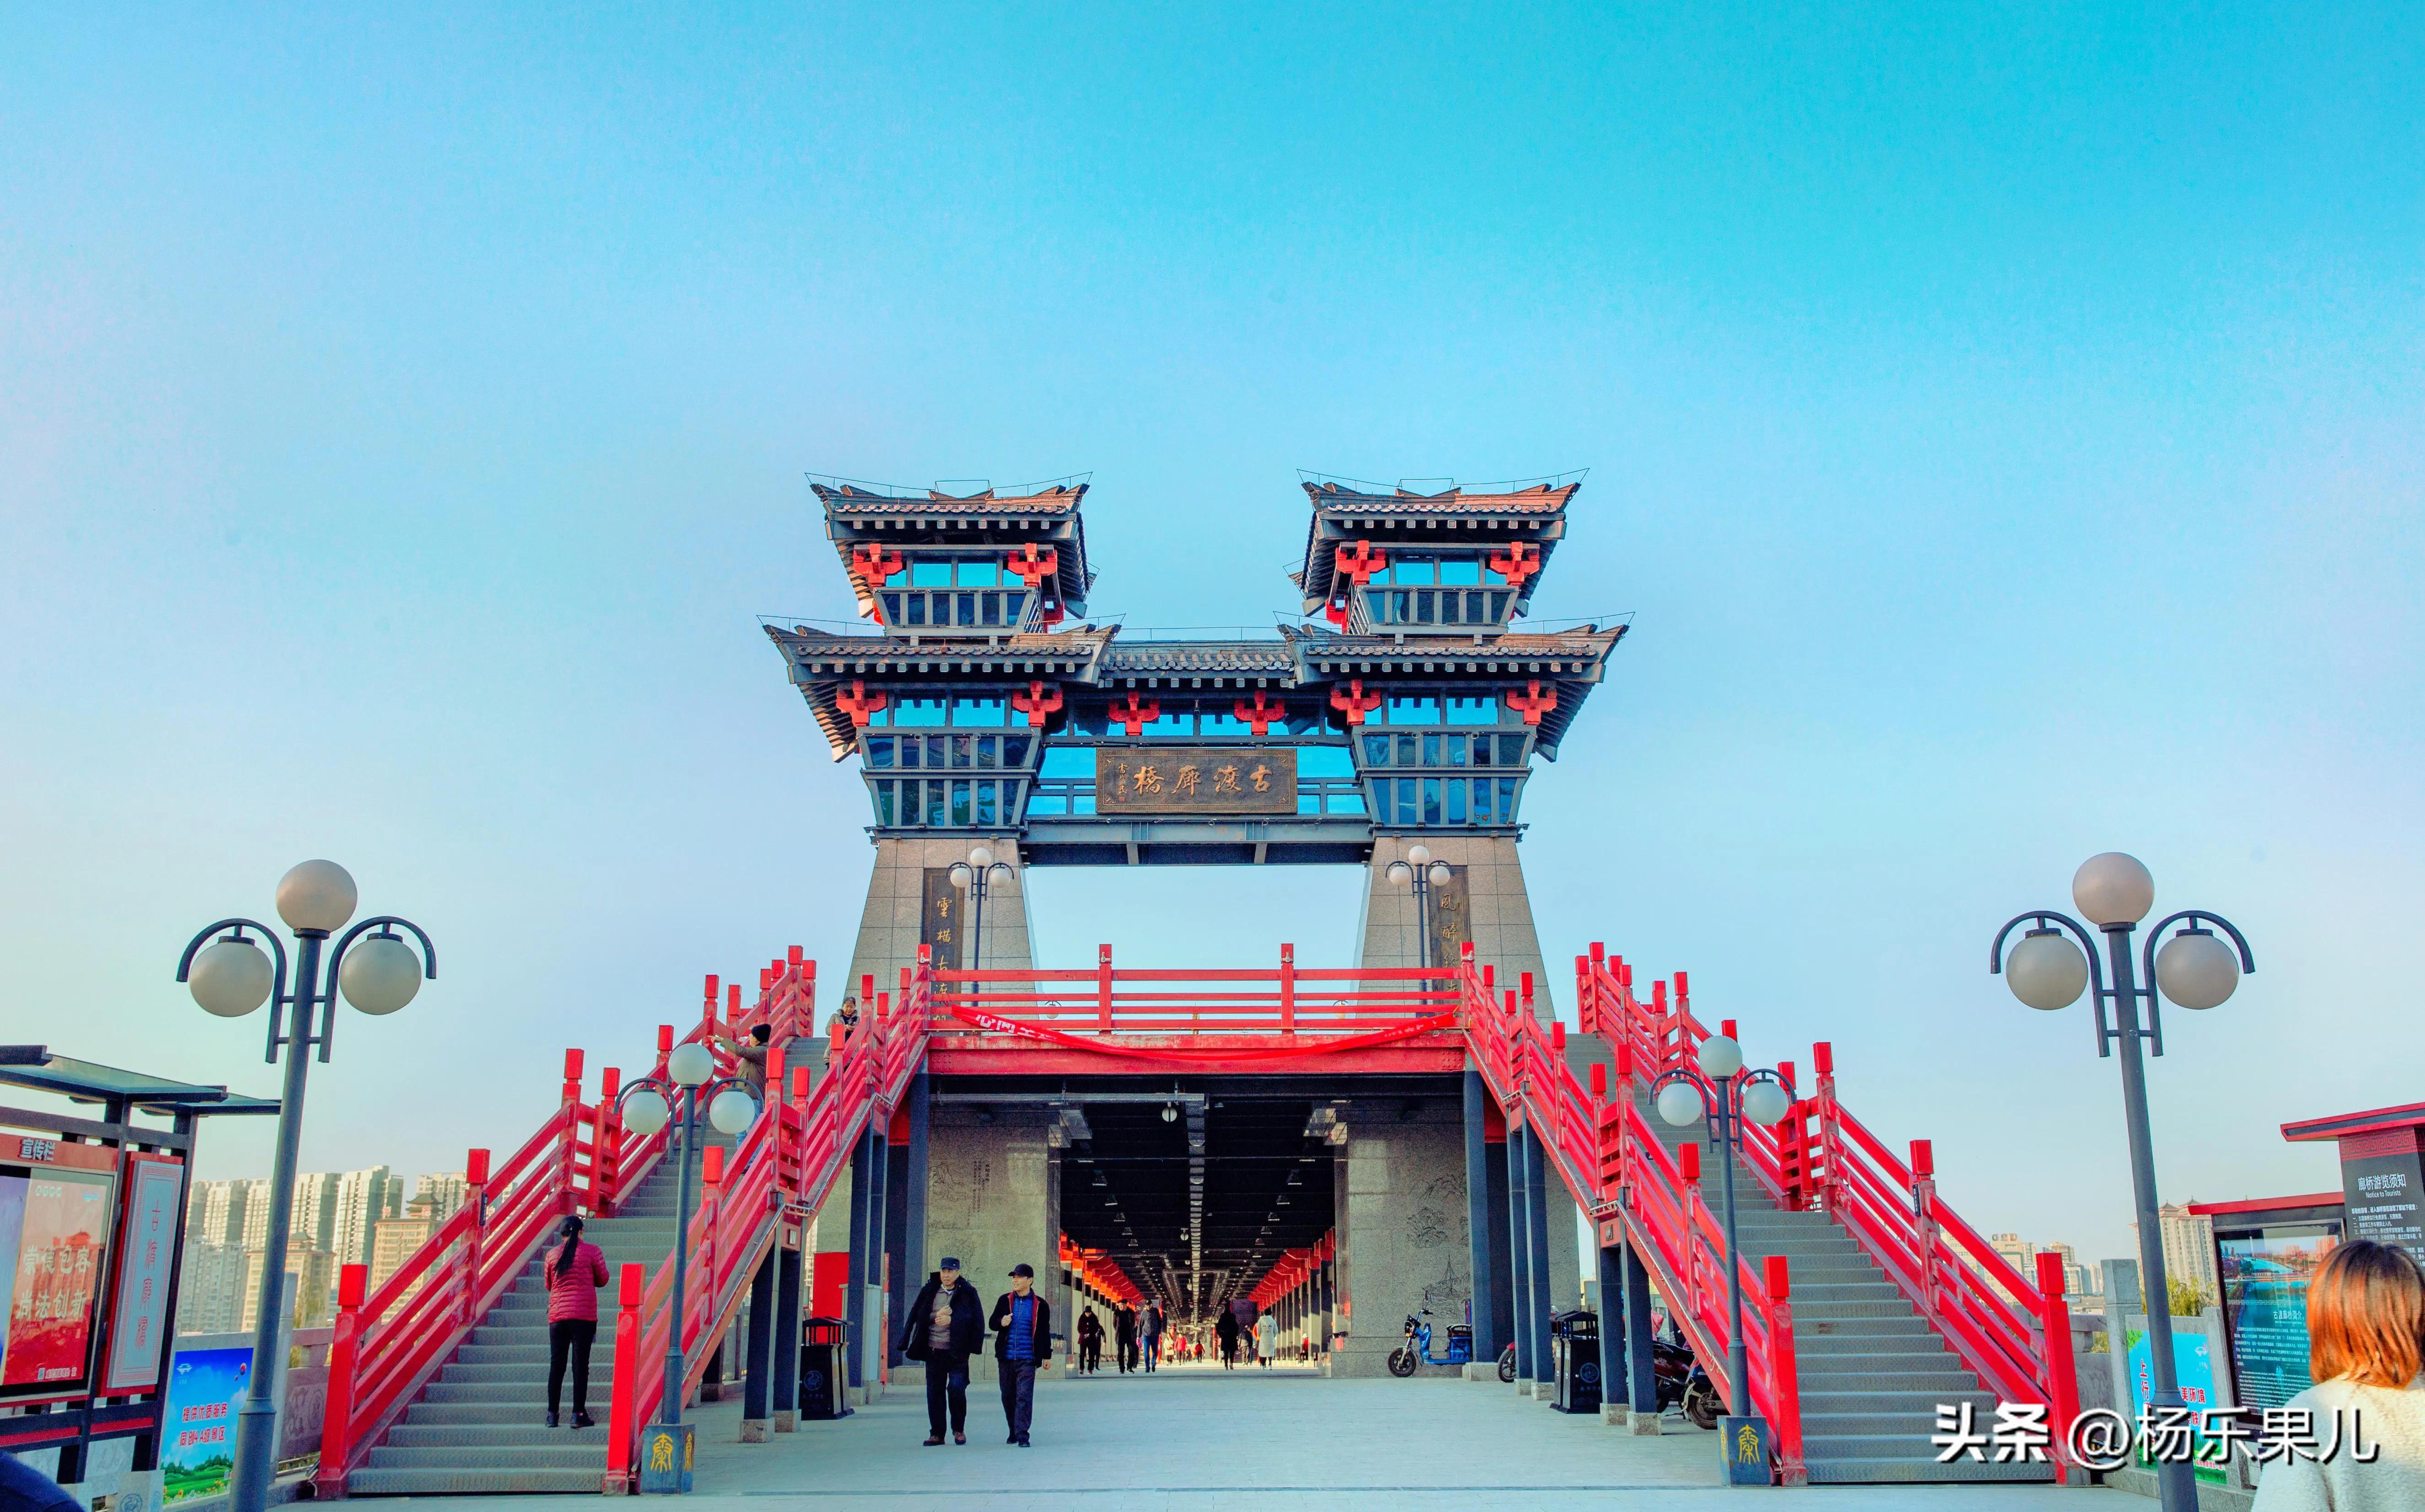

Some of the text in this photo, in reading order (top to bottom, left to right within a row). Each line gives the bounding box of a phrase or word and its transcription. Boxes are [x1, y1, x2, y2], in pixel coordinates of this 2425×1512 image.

[19, 1137, 55, 1162] 宣传栏
[2358, 1173, 2406, 1191] 廊桥游览须知
[23, 1244, 91, 1275] 崇德包容
[16, 1288, 88, 1319] 尚法创新
[2178, 1386, 2206, 1404] 美环境
[183, 1403, 227, 1423] 提供优质服务
